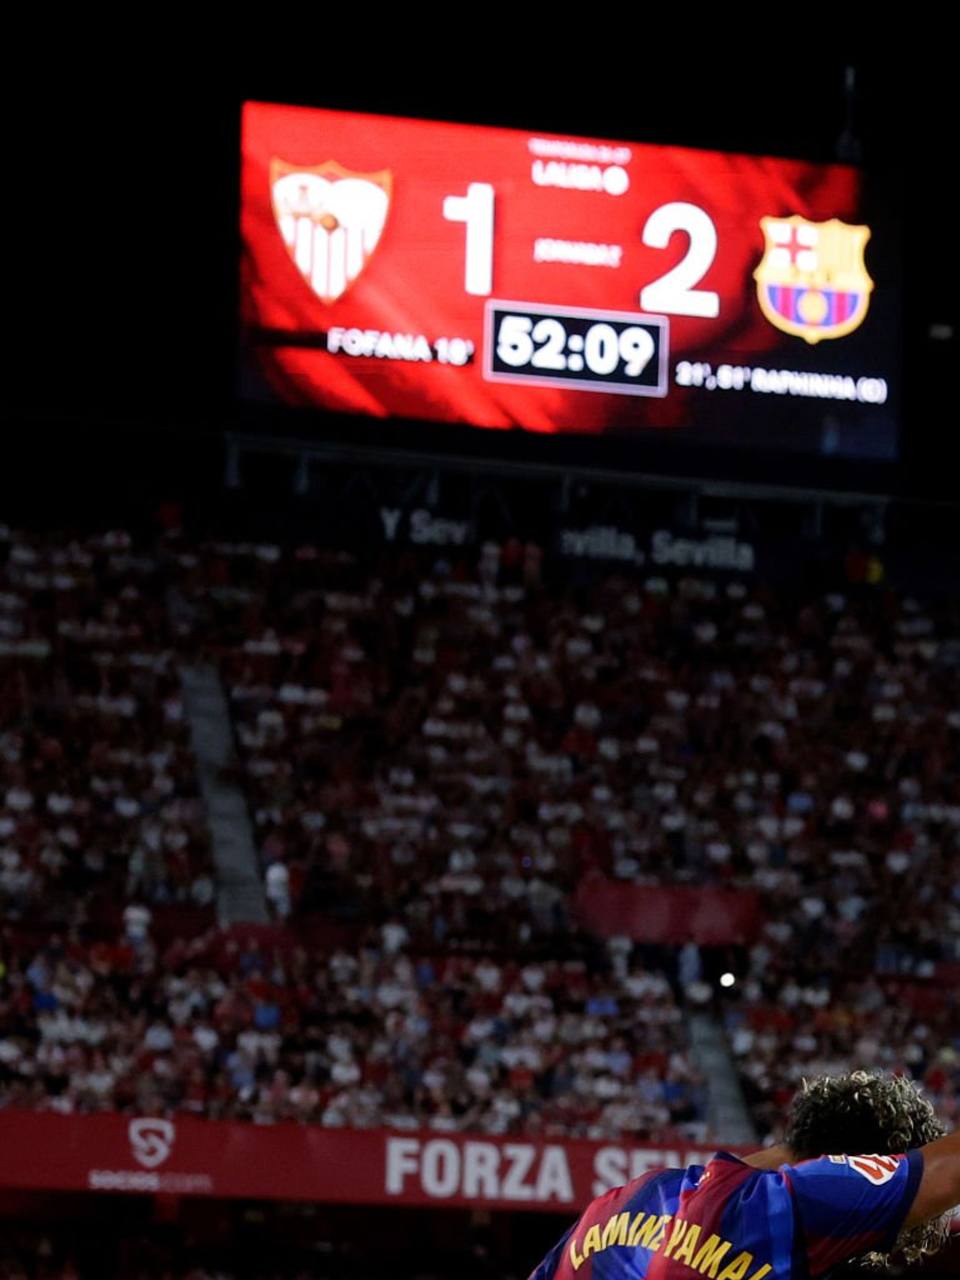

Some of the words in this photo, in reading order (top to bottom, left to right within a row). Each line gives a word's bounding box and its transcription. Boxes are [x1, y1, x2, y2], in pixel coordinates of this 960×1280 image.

[443, 182, 494, 296] 1
[640, 202, 719, 318] 2
[328, 327, 432, 363] FOFANA
[497, 315, 655, 377] 52:09
[384, 1136, 574, 1202] FORZA
[570, 1211, 672, 1270] LAMINE
